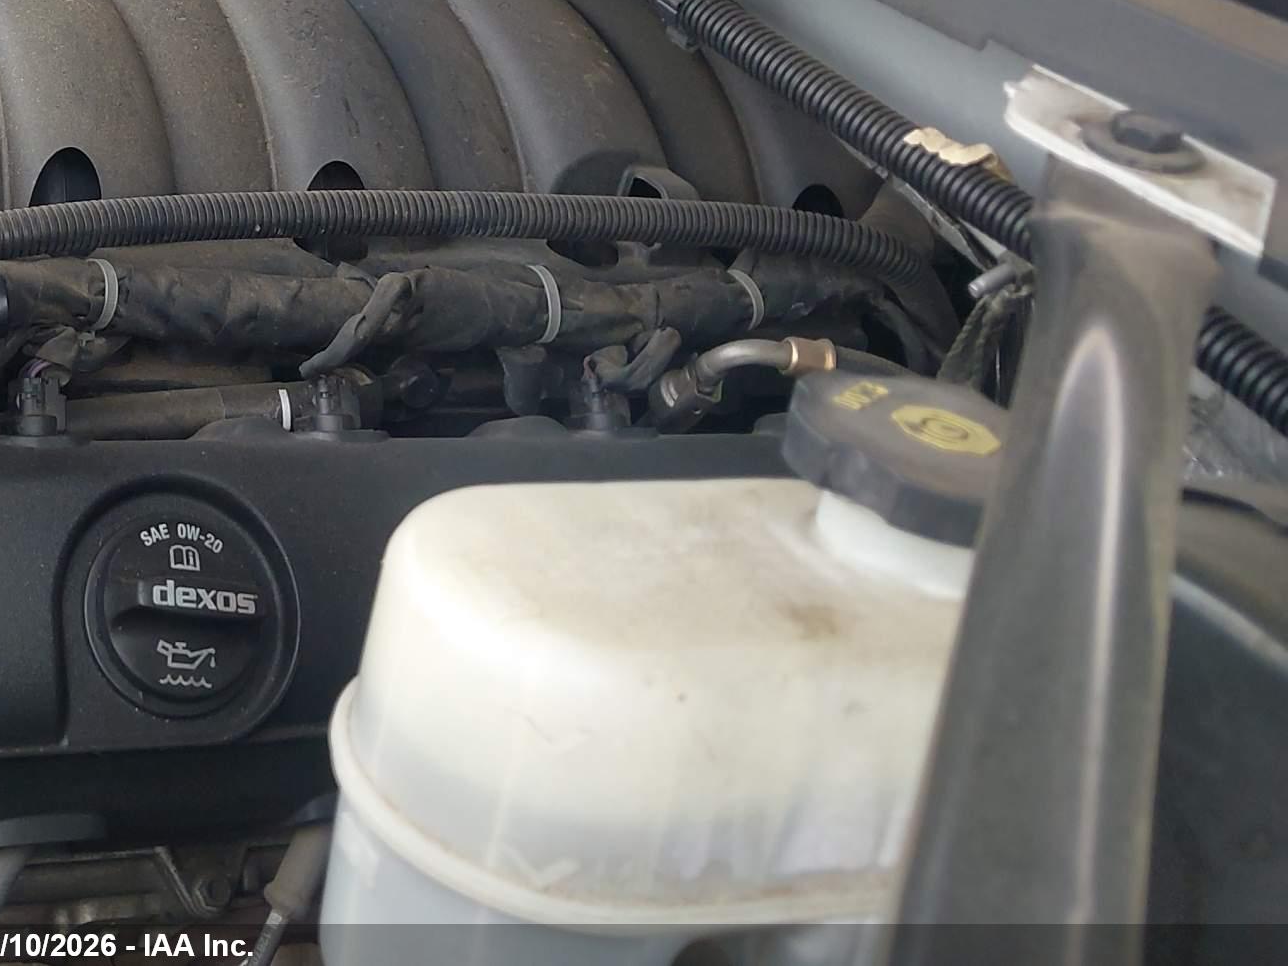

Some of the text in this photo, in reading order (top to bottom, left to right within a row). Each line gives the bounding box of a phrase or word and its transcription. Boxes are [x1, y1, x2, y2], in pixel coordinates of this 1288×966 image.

[139, 522, 224, 554] SAE 0W-20
[152, 579, 257, 615] dexos
